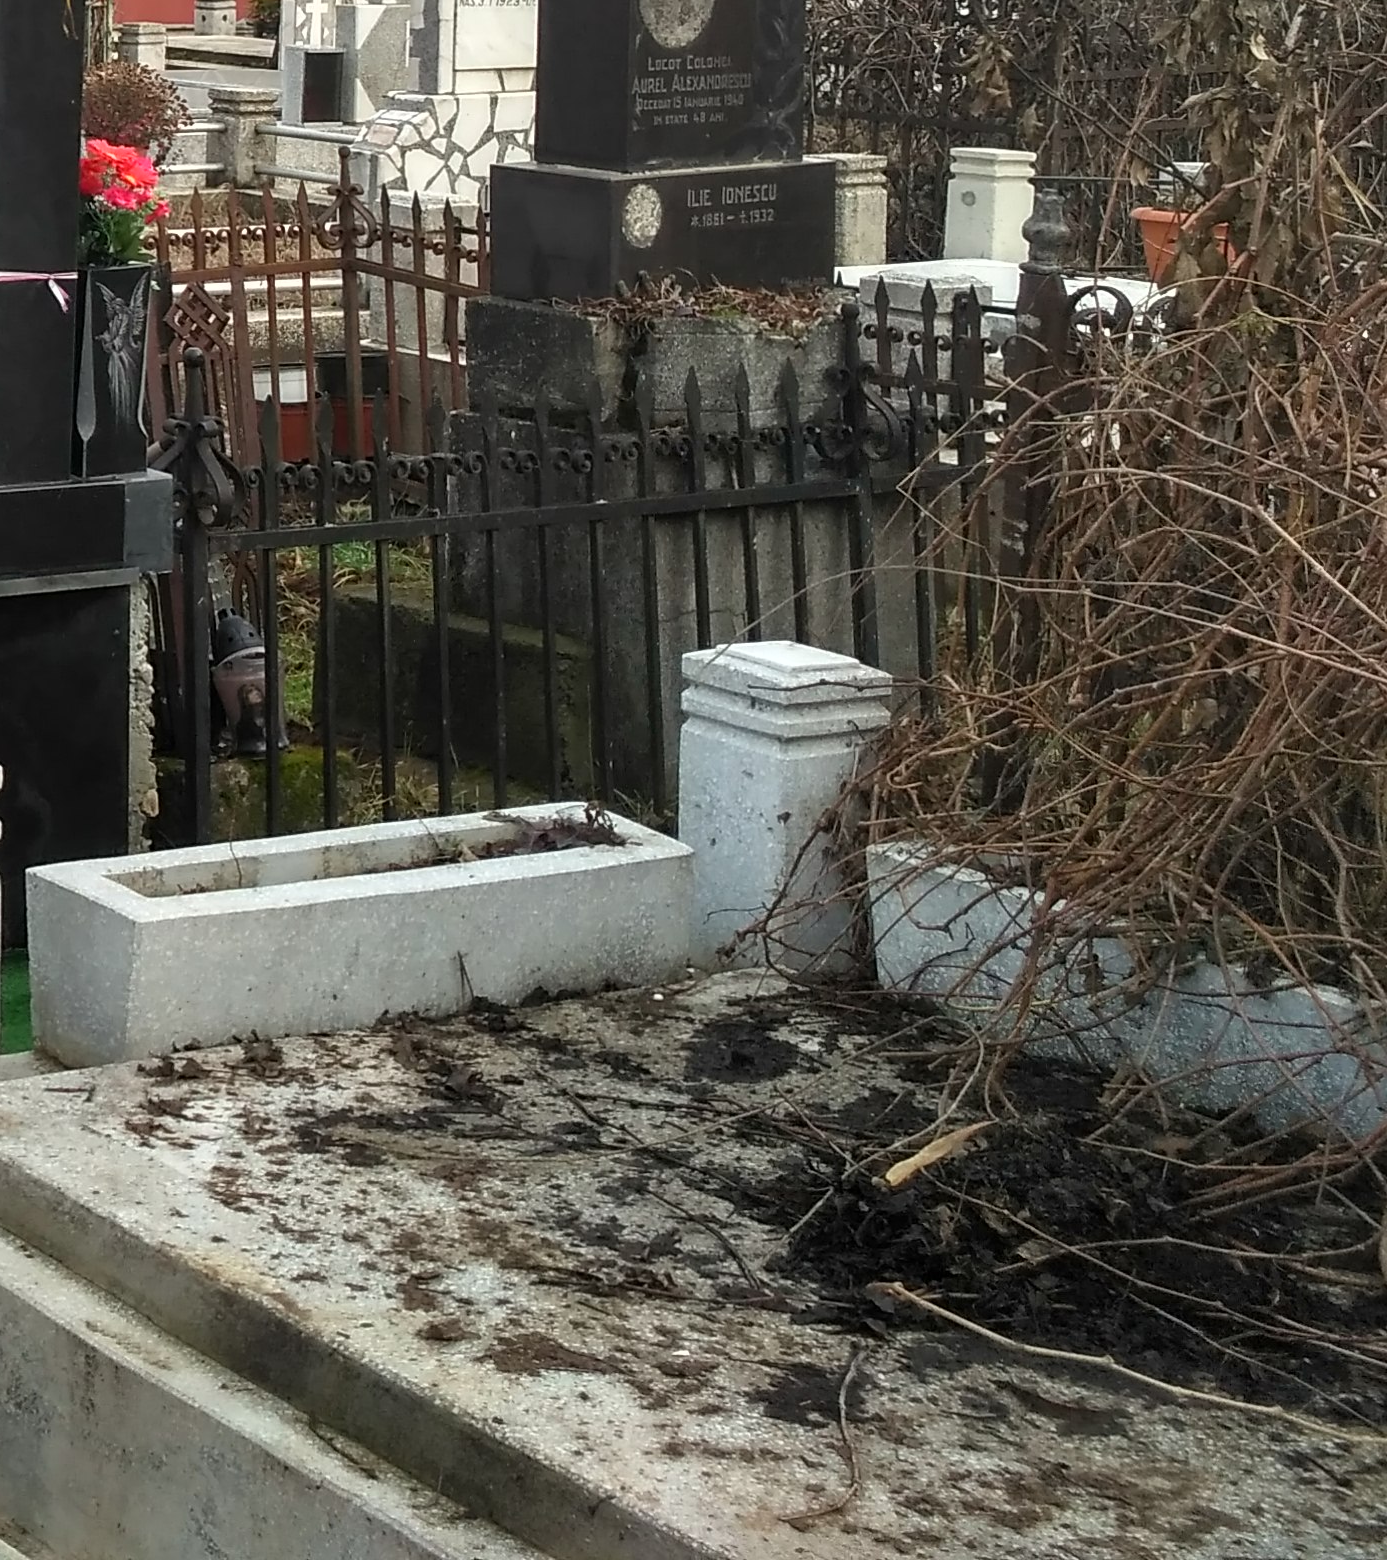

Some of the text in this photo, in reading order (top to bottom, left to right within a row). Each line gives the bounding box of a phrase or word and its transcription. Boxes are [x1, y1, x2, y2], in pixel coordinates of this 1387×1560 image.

[631, 73, 752, 95] AUREL ALEXANDRESCU
[687, 183, 777, 208] ILIE IONESCU
